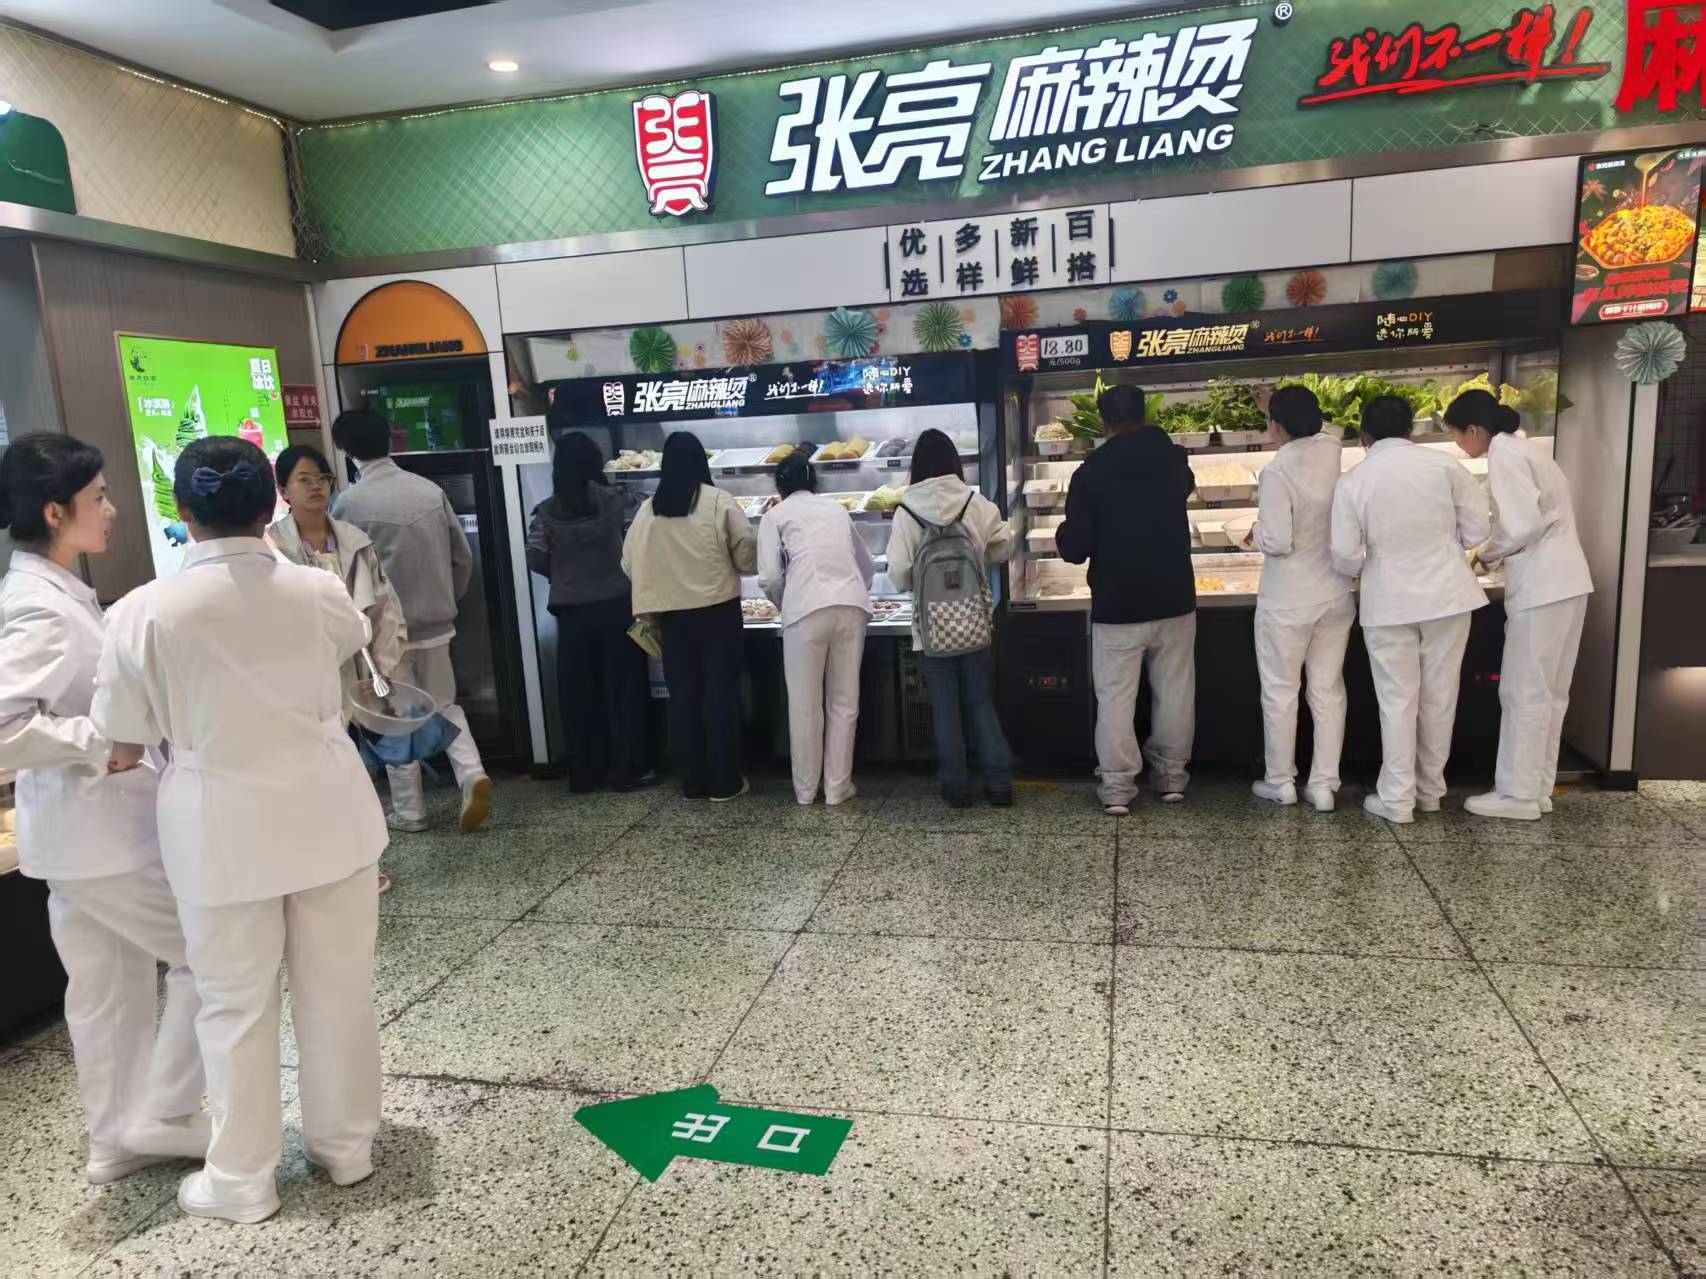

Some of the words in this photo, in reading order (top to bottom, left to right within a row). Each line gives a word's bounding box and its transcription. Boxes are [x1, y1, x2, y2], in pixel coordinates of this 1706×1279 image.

[978, 136, 1106, 182] ZHANG
[1114, 123, 1235, 165] LIANG
[685, 399, 746, 410] ZHANGLIANG
[671, 1112, 811, 1154] 出口
